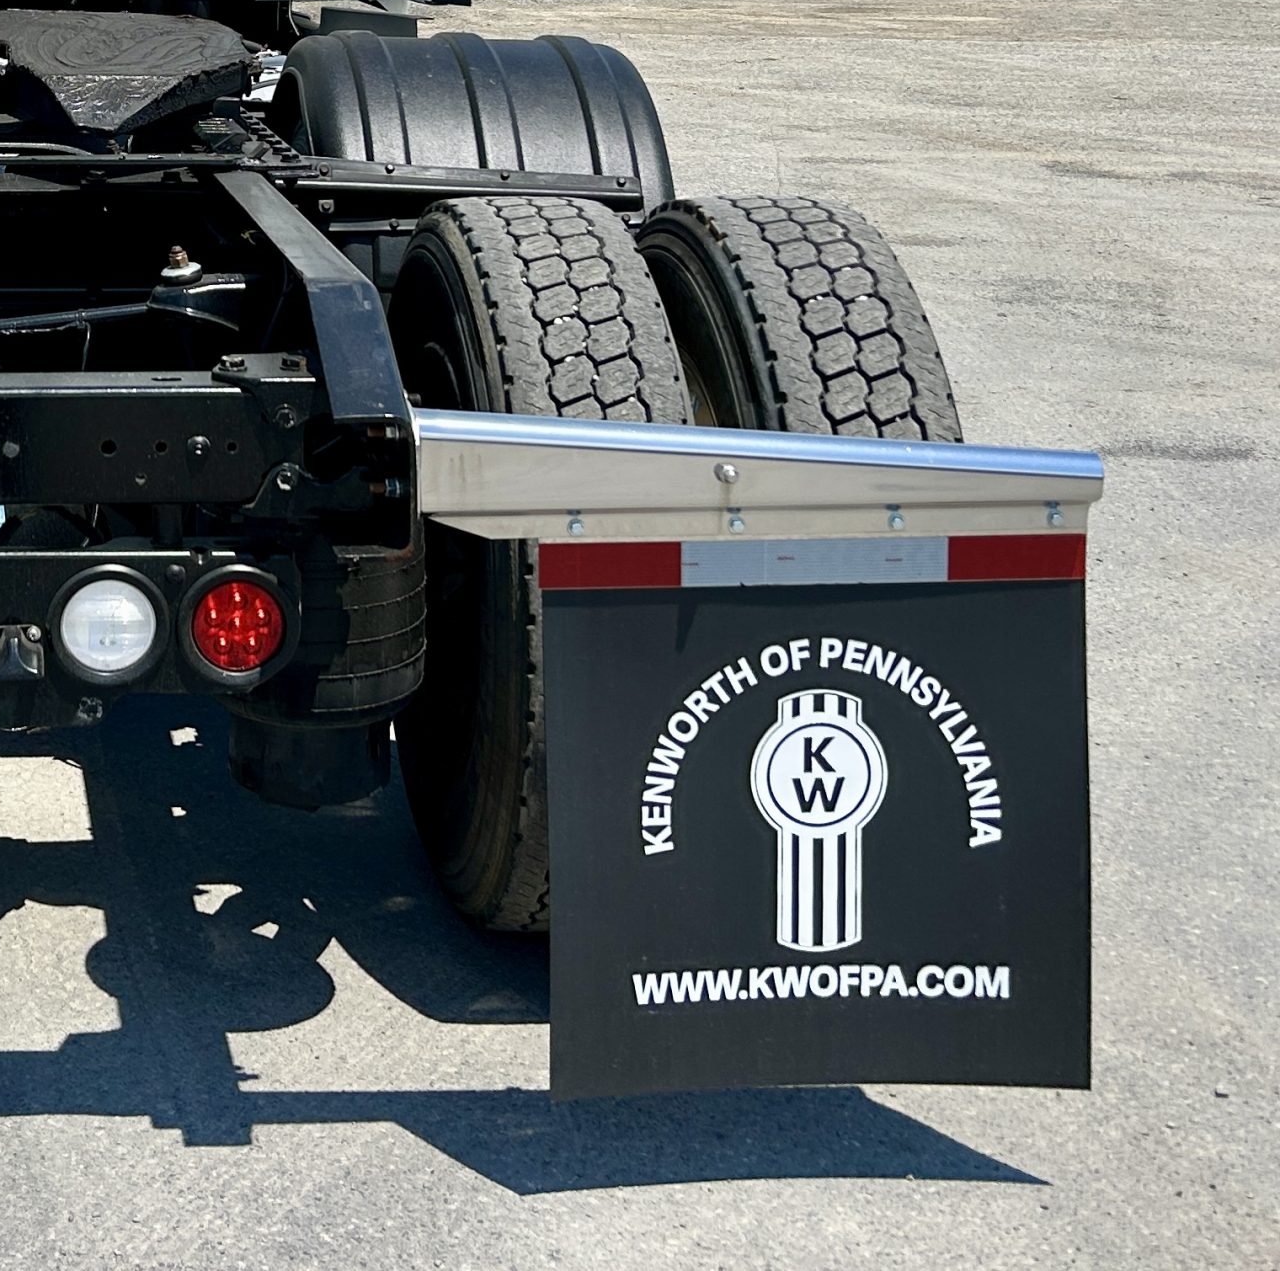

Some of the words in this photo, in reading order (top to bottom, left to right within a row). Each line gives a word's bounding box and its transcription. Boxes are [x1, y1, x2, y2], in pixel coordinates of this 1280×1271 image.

[642, 657, 759, 856] KENWORTH
[760, 638, 811, 677] OF
[819, 637, 1002, 848] PENNSYLVANIA
[632, 964, 1010, 1006] WWW.KWOFPA.COM
